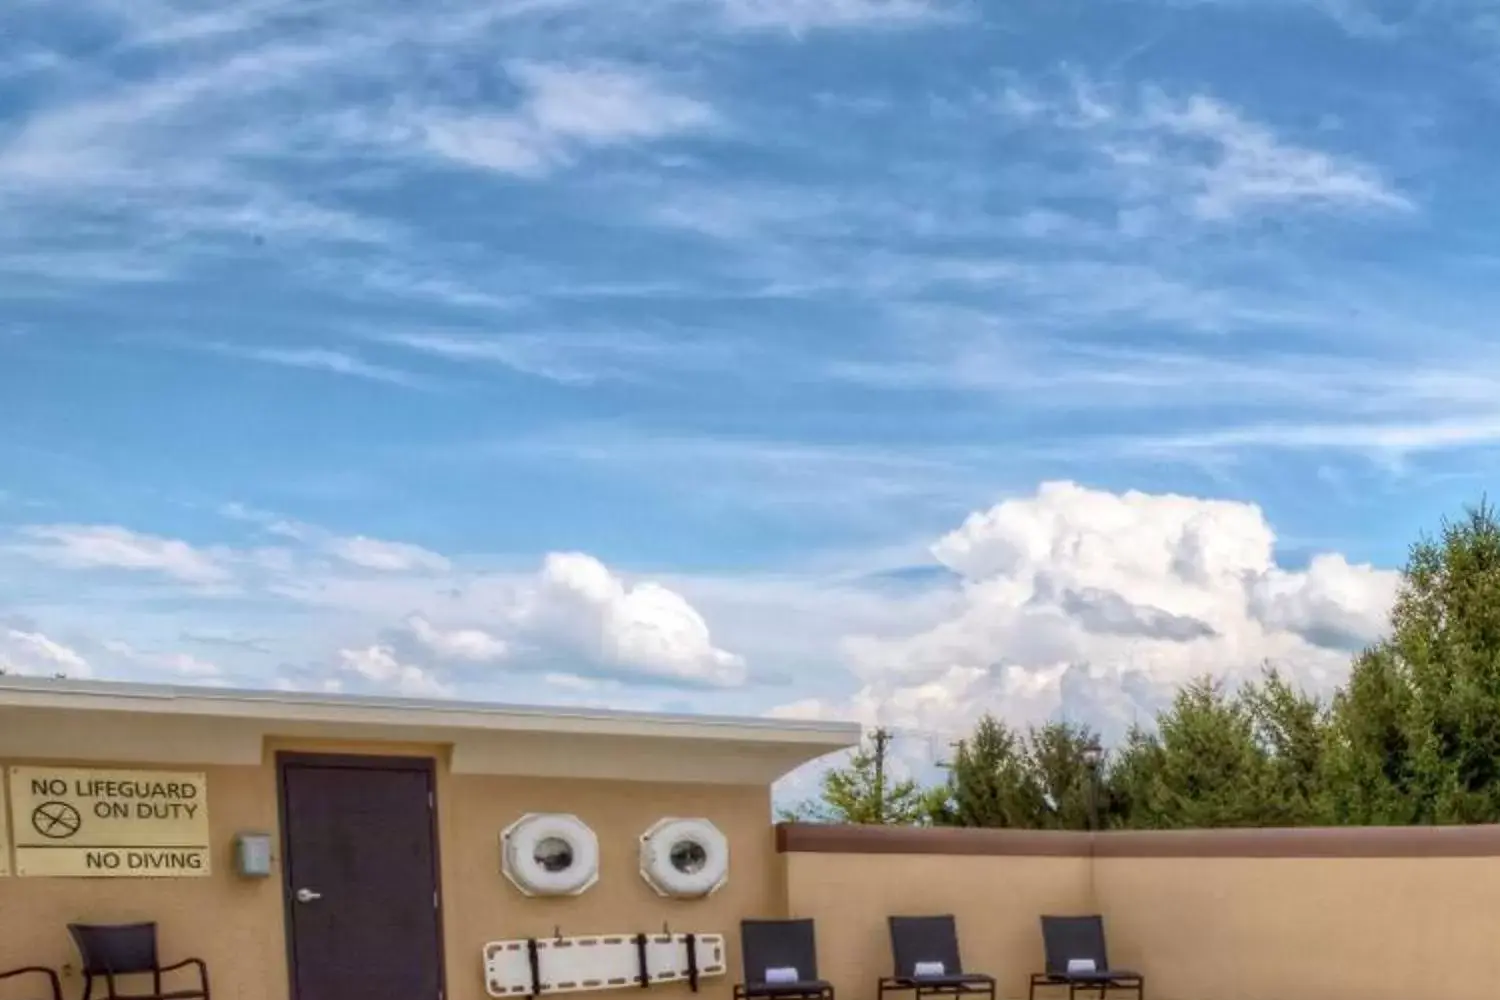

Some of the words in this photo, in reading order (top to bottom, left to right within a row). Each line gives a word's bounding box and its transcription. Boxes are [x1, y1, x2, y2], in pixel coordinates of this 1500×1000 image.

[31, 779, 67, 796] NO
[75, 781, 197, 799] LIFEGUARD
[94, 801, 129, 818] ON
[137, 803, 198, 819] DUTY
[86, 851, 120, 869] NO
[128, 853, 201, 869] DIVING
